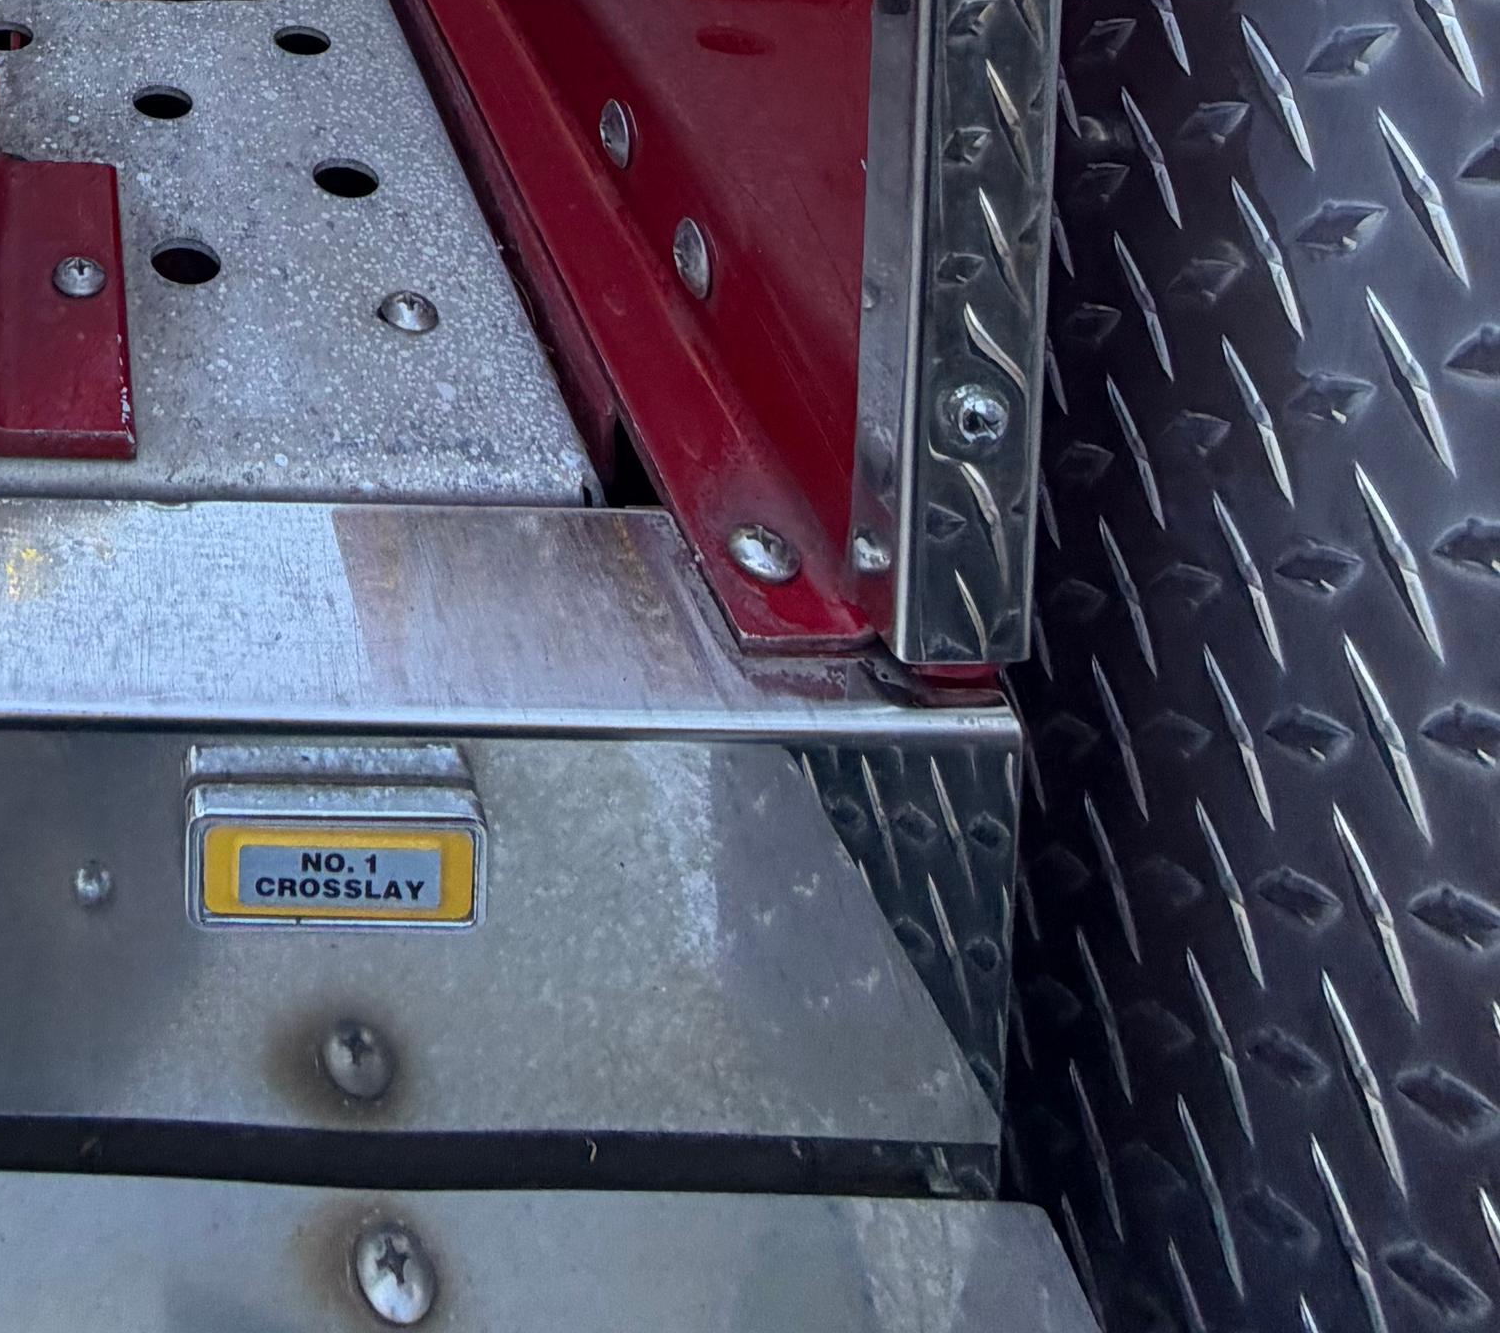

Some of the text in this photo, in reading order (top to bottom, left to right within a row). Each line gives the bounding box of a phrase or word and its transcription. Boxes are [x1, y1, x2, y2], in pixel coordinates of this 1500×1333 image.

[301, 852, 377, 875] NO. 1
[255, 876, 425, 901] CROSSLAY
